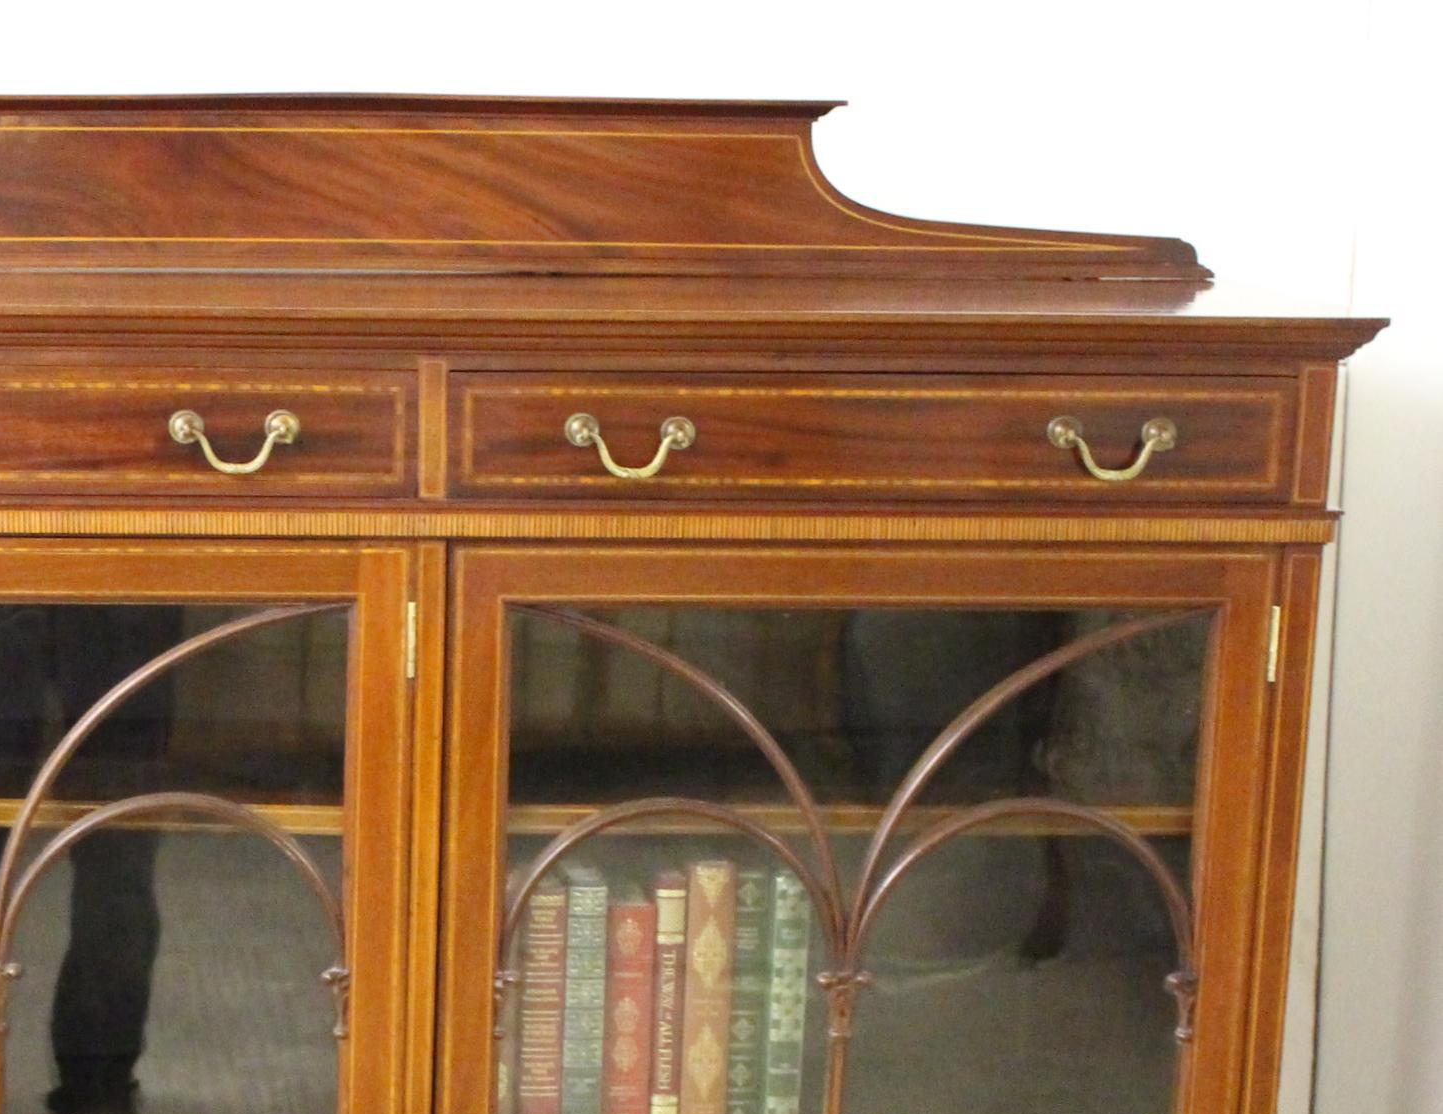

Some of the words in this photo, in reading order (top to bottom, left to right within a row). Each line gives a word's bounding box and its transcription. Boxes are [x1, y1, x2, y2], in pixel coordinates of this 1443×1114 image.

[660, 950, 676, 978] THE
[660, 982, 675, 1009] WAY
[658, 1021, 672, 1045] ALL
[657, 1048, 672, 1090] FLESH
